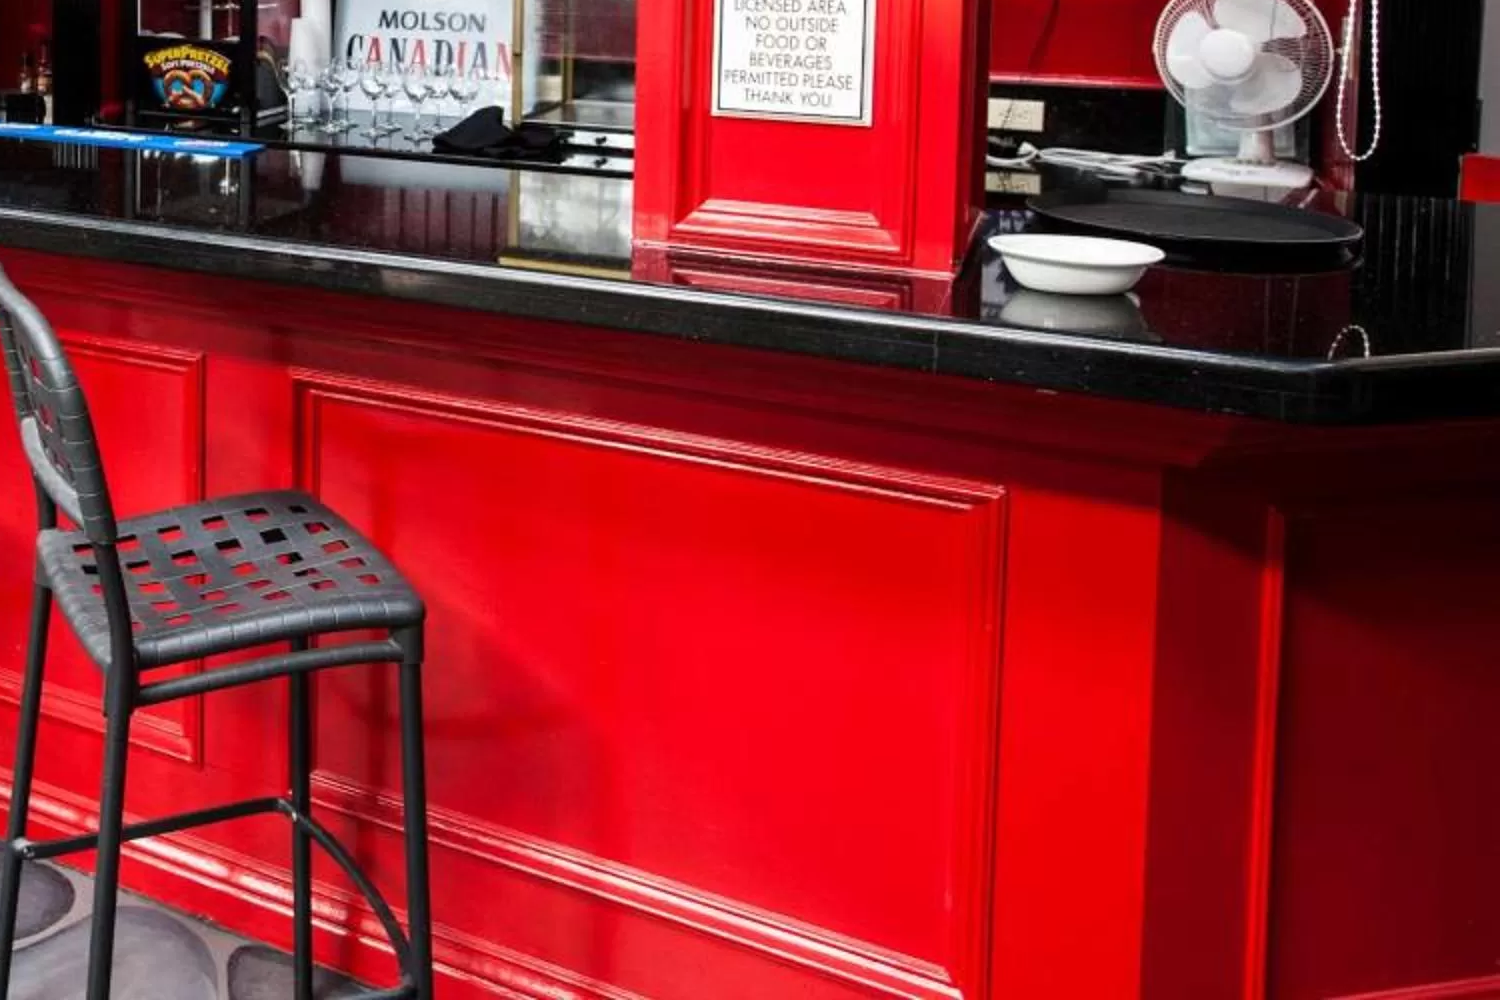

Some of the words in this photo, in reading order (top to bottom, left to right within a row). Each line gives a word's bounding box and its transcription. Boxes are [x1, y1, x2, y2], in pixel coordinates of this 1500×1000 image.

[806, 0, 847, 15] AREA
[377, 8, 487, 33] MOLSON
[744, 15, 771, 31] NO
[775, 16, 839, 33] OUTSIDE
[755, 34, 799, 50] FOOD
[804, 36, 828, 51] OR
[346, 33, 512, 81] CANADIAN
[749, 52, 833, 70] BEVERAGES
[723, 69, 799, 86] PERMITTED
[802, 73, 853, 91] PLEASE
[744, 88, 794, 105] THANK
[799, 91, 833, 107] YOU
